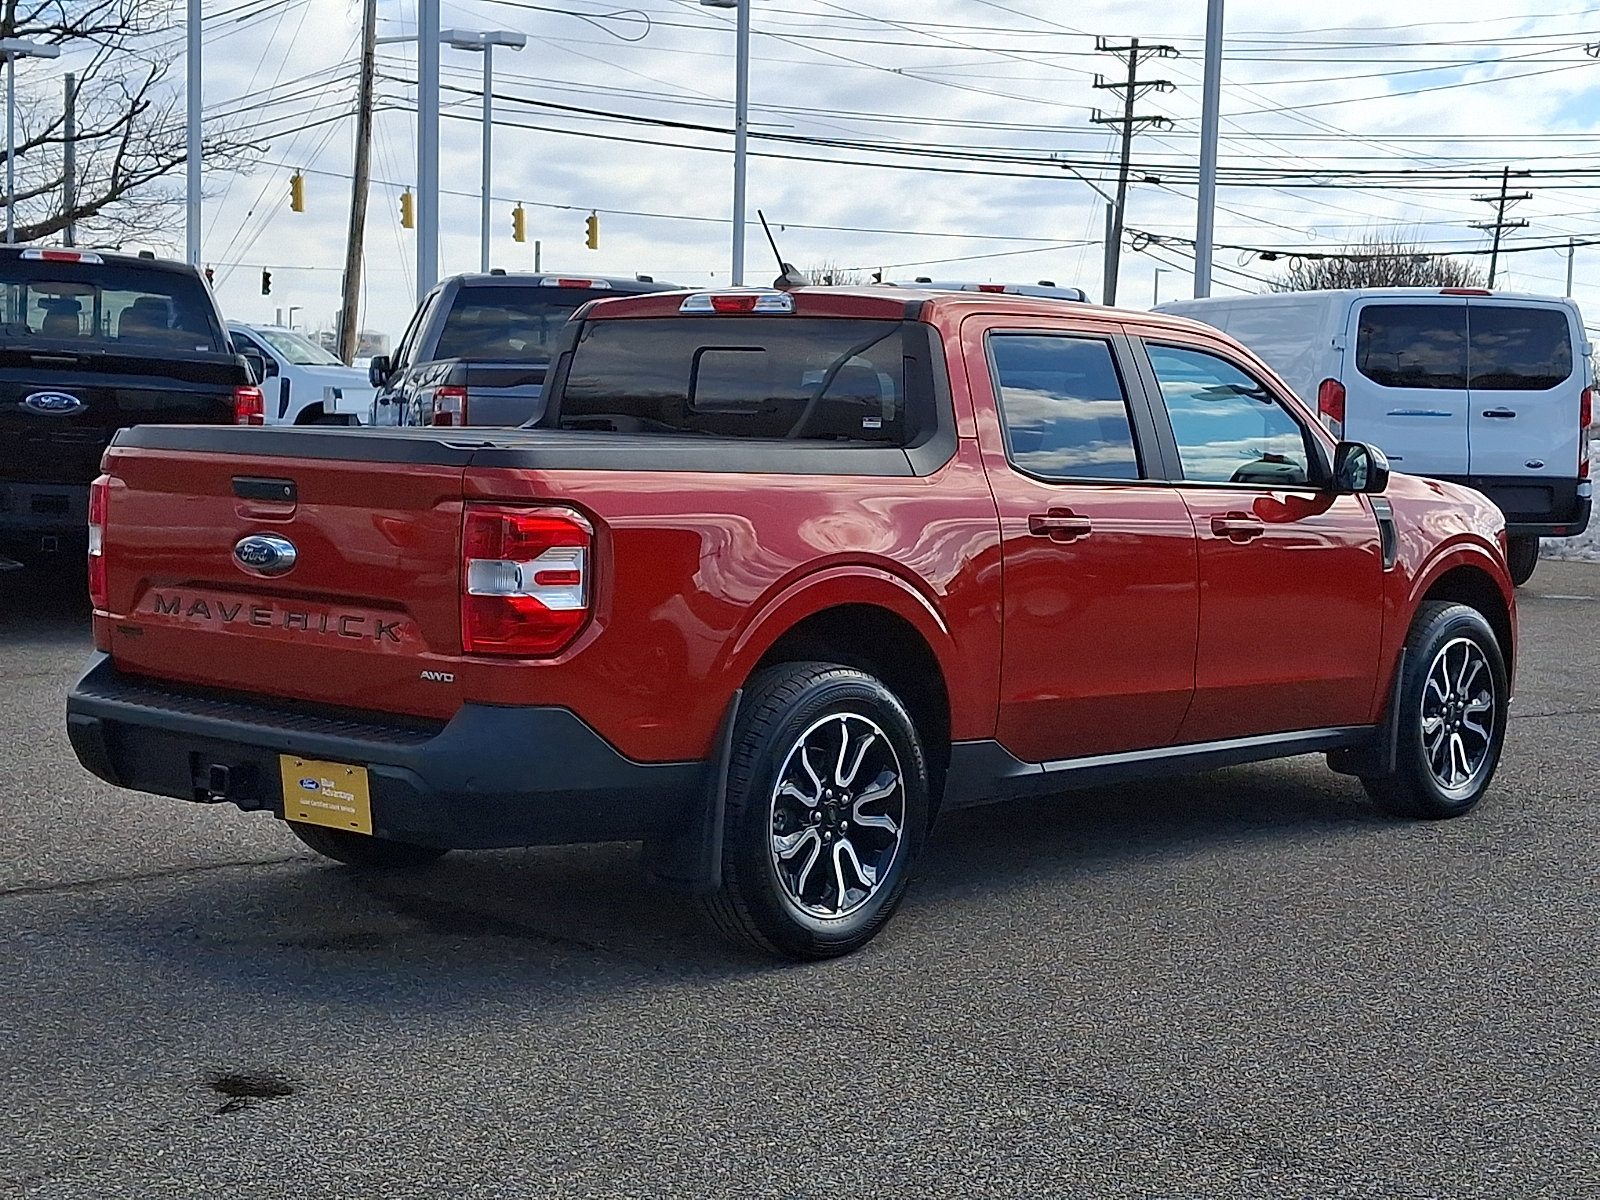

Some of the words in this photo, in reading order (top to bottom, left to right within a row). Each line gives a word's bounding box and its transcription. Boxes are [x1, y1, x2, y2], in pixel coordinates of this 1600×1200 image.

[241, 543, 268, 561] Ford
[154, 594, 402, 643] MAVERICK
[420, 670, 454, 682] AWD
